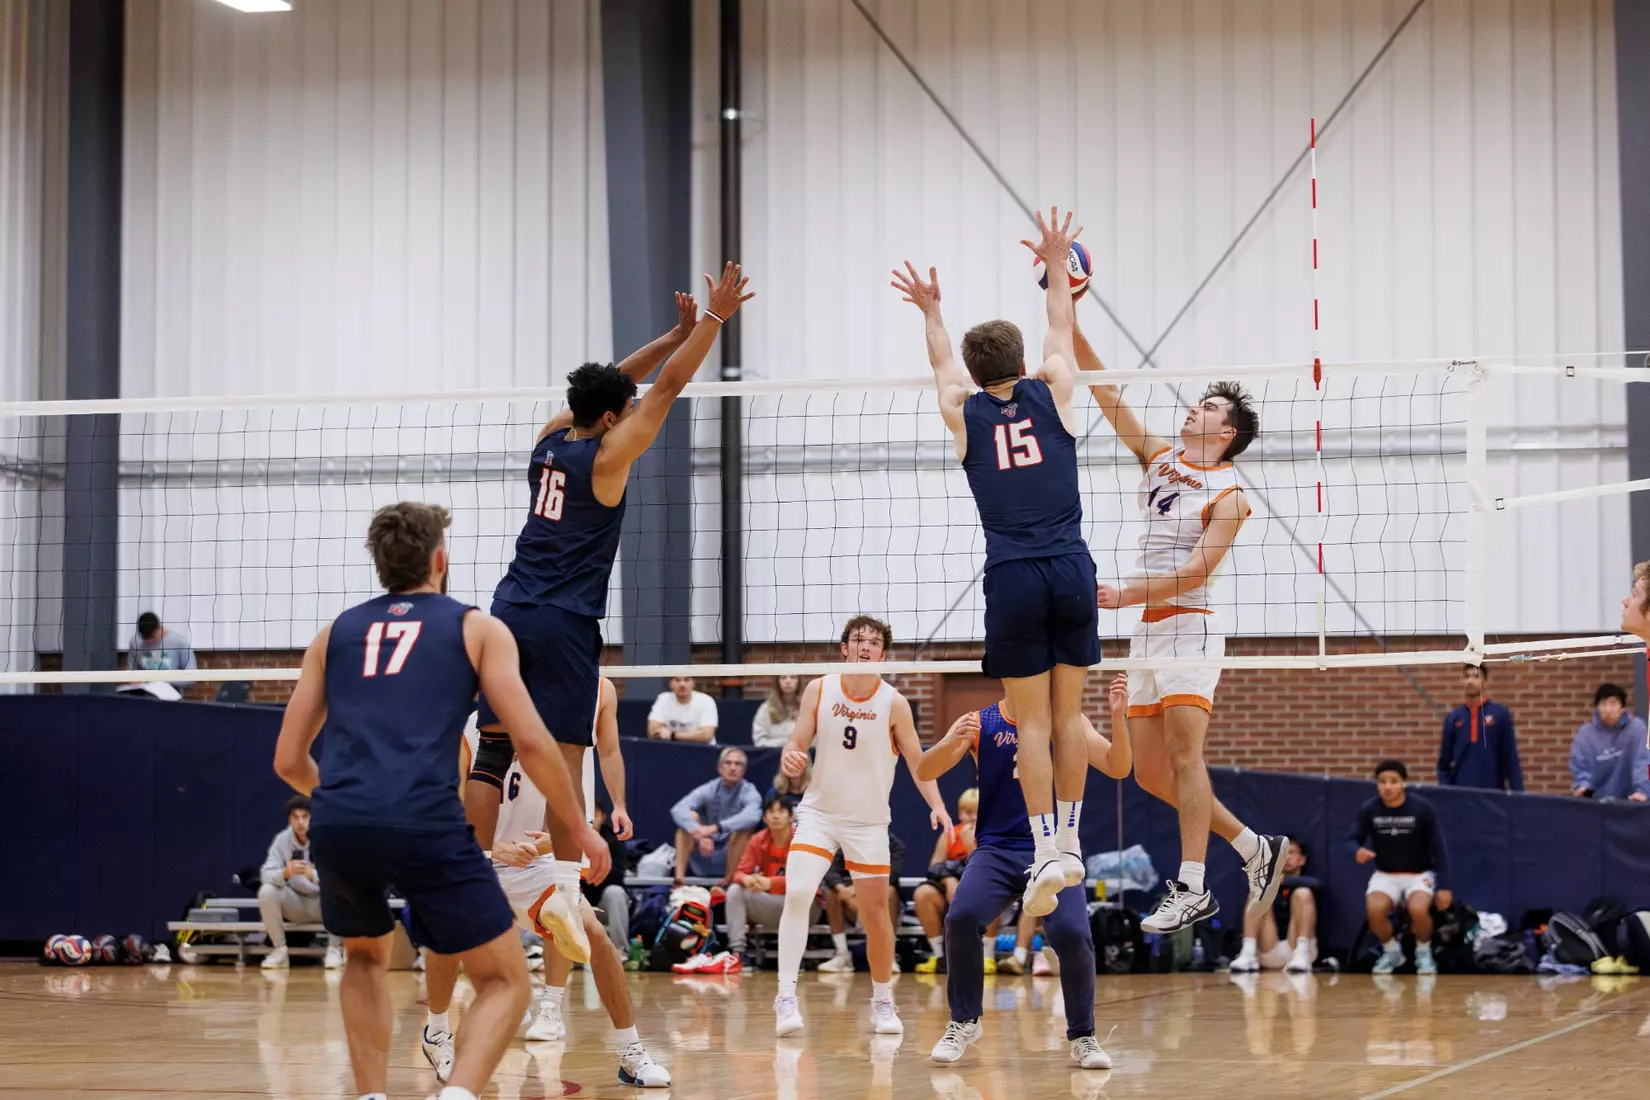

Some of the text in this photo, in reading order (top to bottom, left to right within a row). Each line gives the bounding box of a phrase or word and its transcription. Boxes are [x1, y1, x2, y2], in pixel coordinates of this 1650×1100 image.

[993, 417, 1044, 472] 15
[1158, 462, 1203, 489] Virginia
[533, 465, 567, 522] 16
[1147, 485, 1180, 516] 14
[362, 619, 423, 679] 17
[832, 702, 877, 723] Virginia
[842, 725, 858, 751] 9
